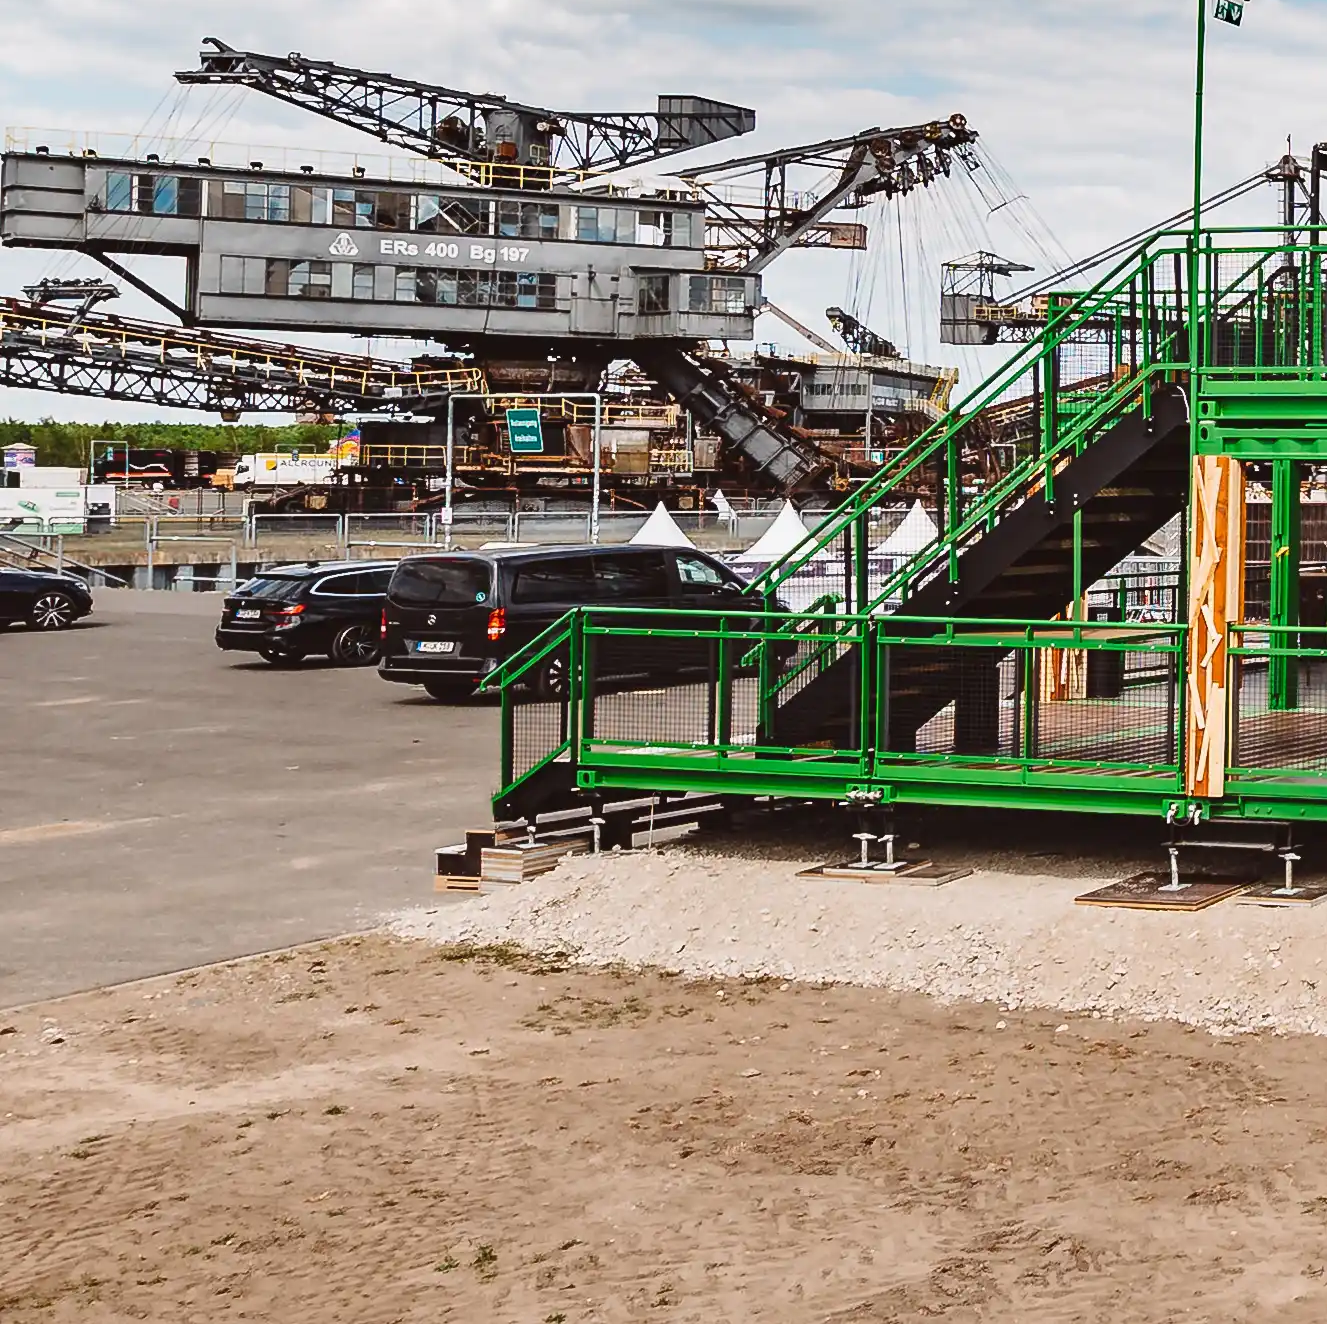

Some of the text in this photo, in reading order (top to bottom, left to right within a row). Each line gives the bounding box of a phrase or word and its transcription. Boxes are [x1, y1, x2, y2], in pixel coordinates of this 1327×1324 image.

[379, 239, 530, 264] ERs 400 Bg 197
